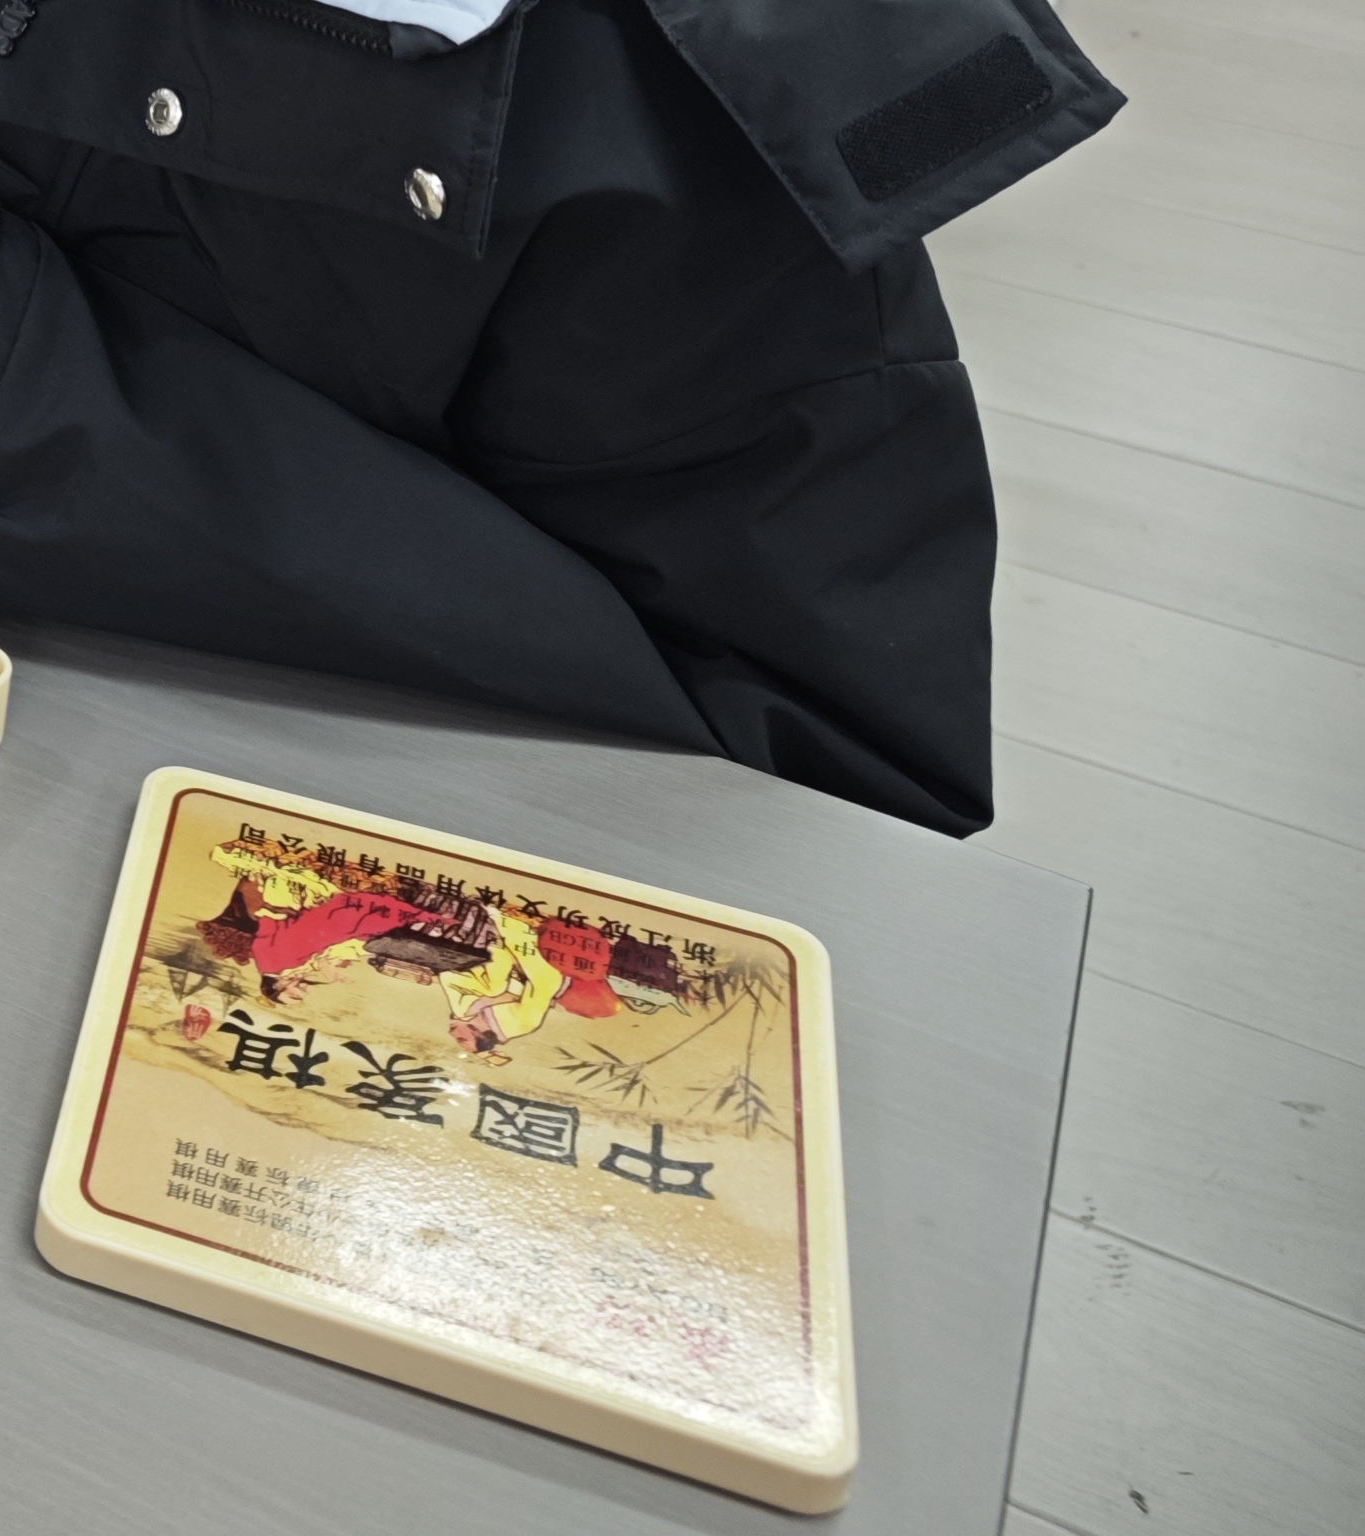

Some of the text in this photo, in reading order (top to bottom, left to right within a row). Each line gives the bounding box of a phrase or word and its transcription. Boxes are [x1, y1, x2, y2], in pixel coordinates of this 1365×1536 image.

[238, 821, 717, 966] 浙江成功文体用品有限公司
[216, 1007, 716, 1201] 中國象棋
